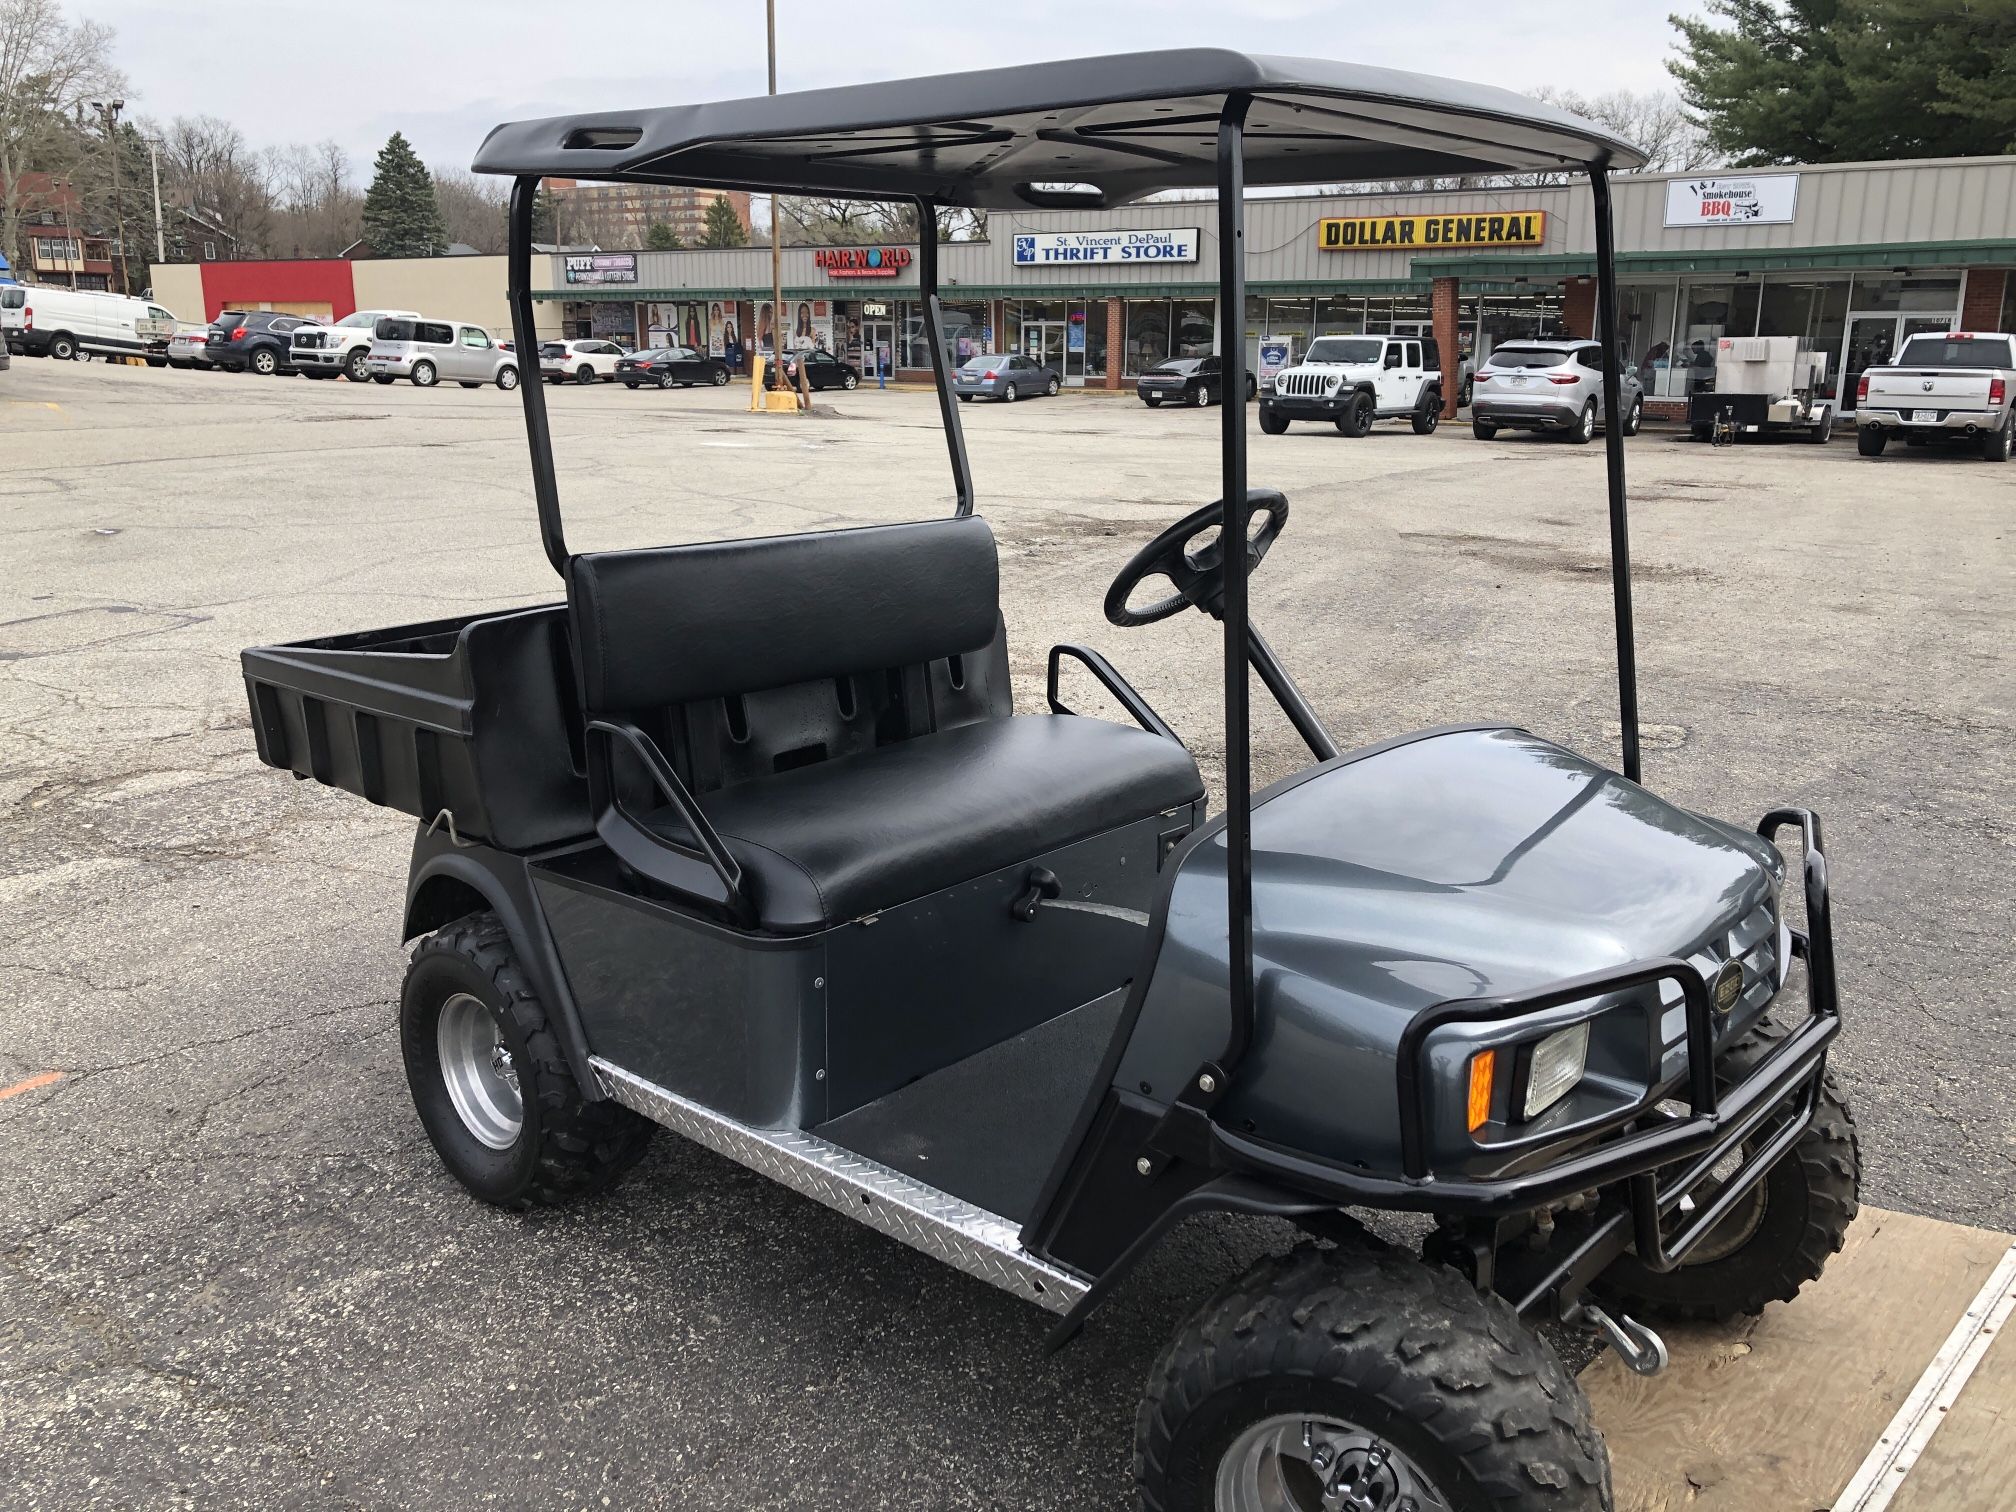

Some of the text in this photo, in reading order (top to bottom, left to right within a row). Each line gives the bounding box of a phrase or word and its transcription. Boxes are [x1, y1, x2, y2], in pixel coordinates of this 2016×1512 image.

[1702, 190, 1752, 200] Smokehouse
[1701, 200, 1731, 217] BBQ
[1325, 215, 1536, 246] DOLLAR GENERAL
[1056, 233, 1172, 247] St. Vincent DePaul
[815, 247, 911, 268] HAIR WORLD
[1041, 244, 1188, 261] THRIFT STORE
[566, 256, 593, 270] PUFF
[864, 304, 886, 316] OPEN
